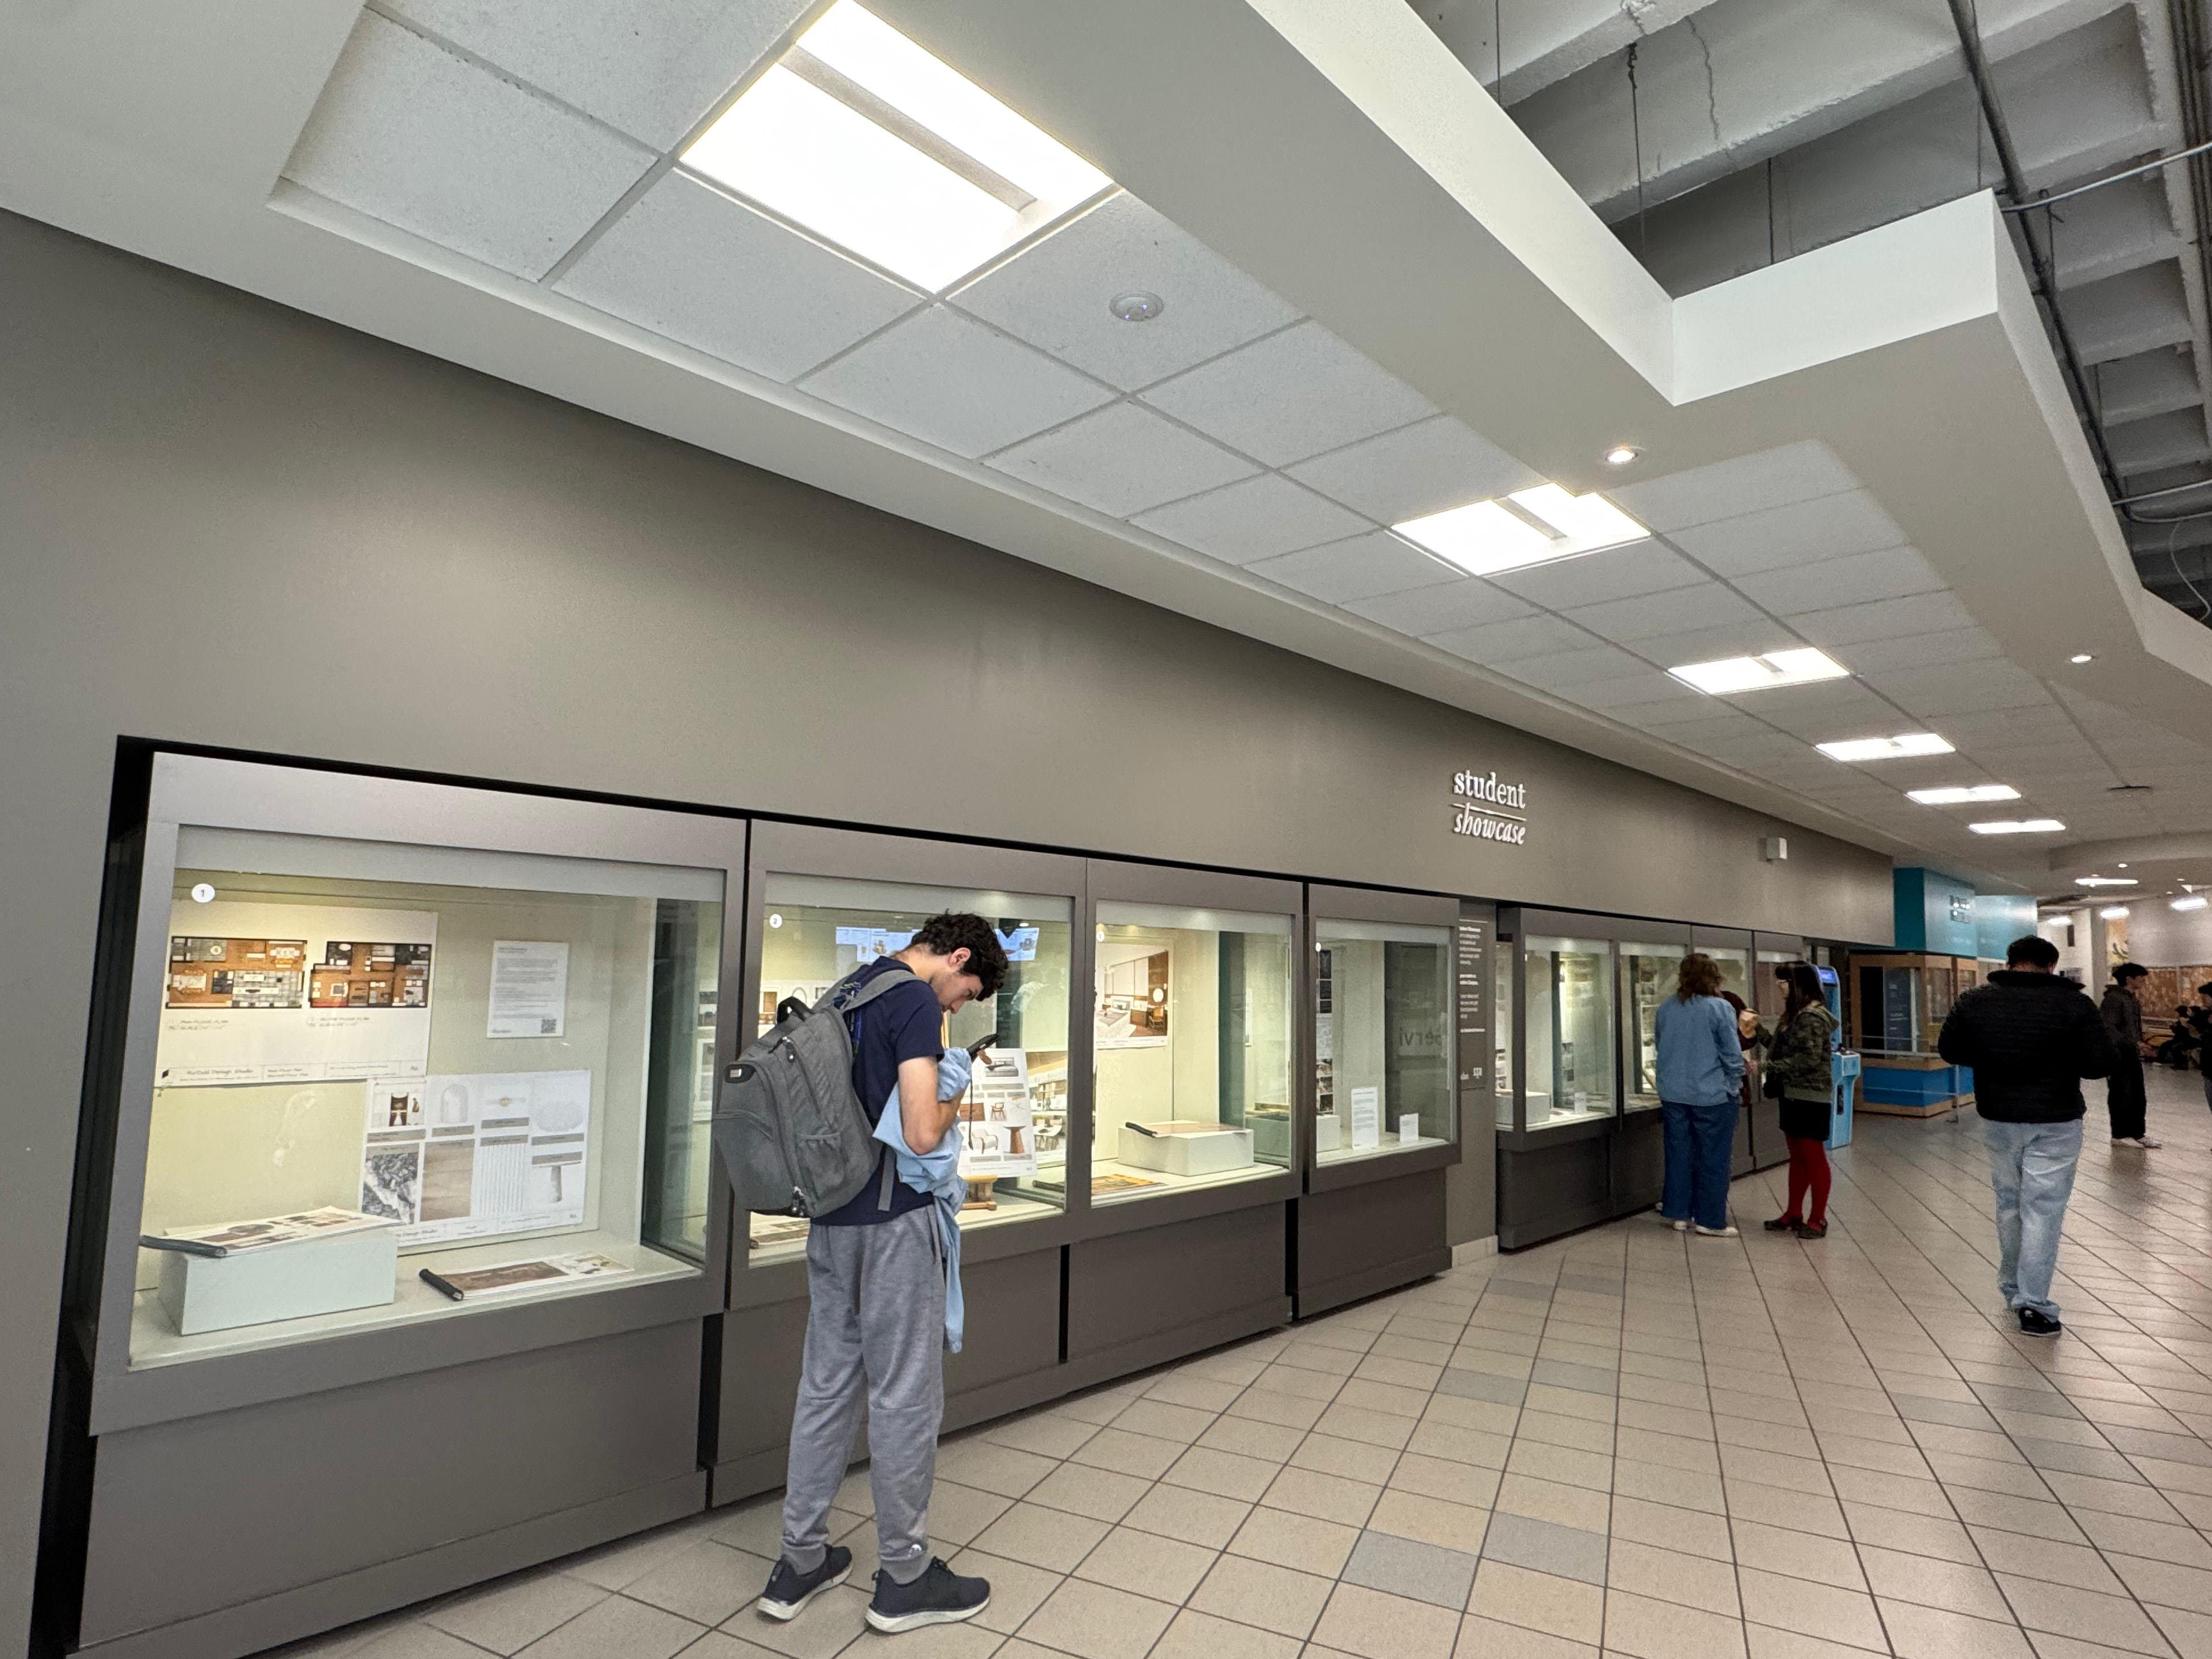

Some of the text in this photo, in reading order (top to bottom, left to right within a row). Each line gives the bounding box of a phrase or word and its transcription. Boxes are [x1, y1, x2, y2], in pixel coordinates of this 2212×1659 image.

[1454, 770, 1526, 809] student
[1454, 802, 1526, 845] showcase
[201, 889, 205, 898] 1
